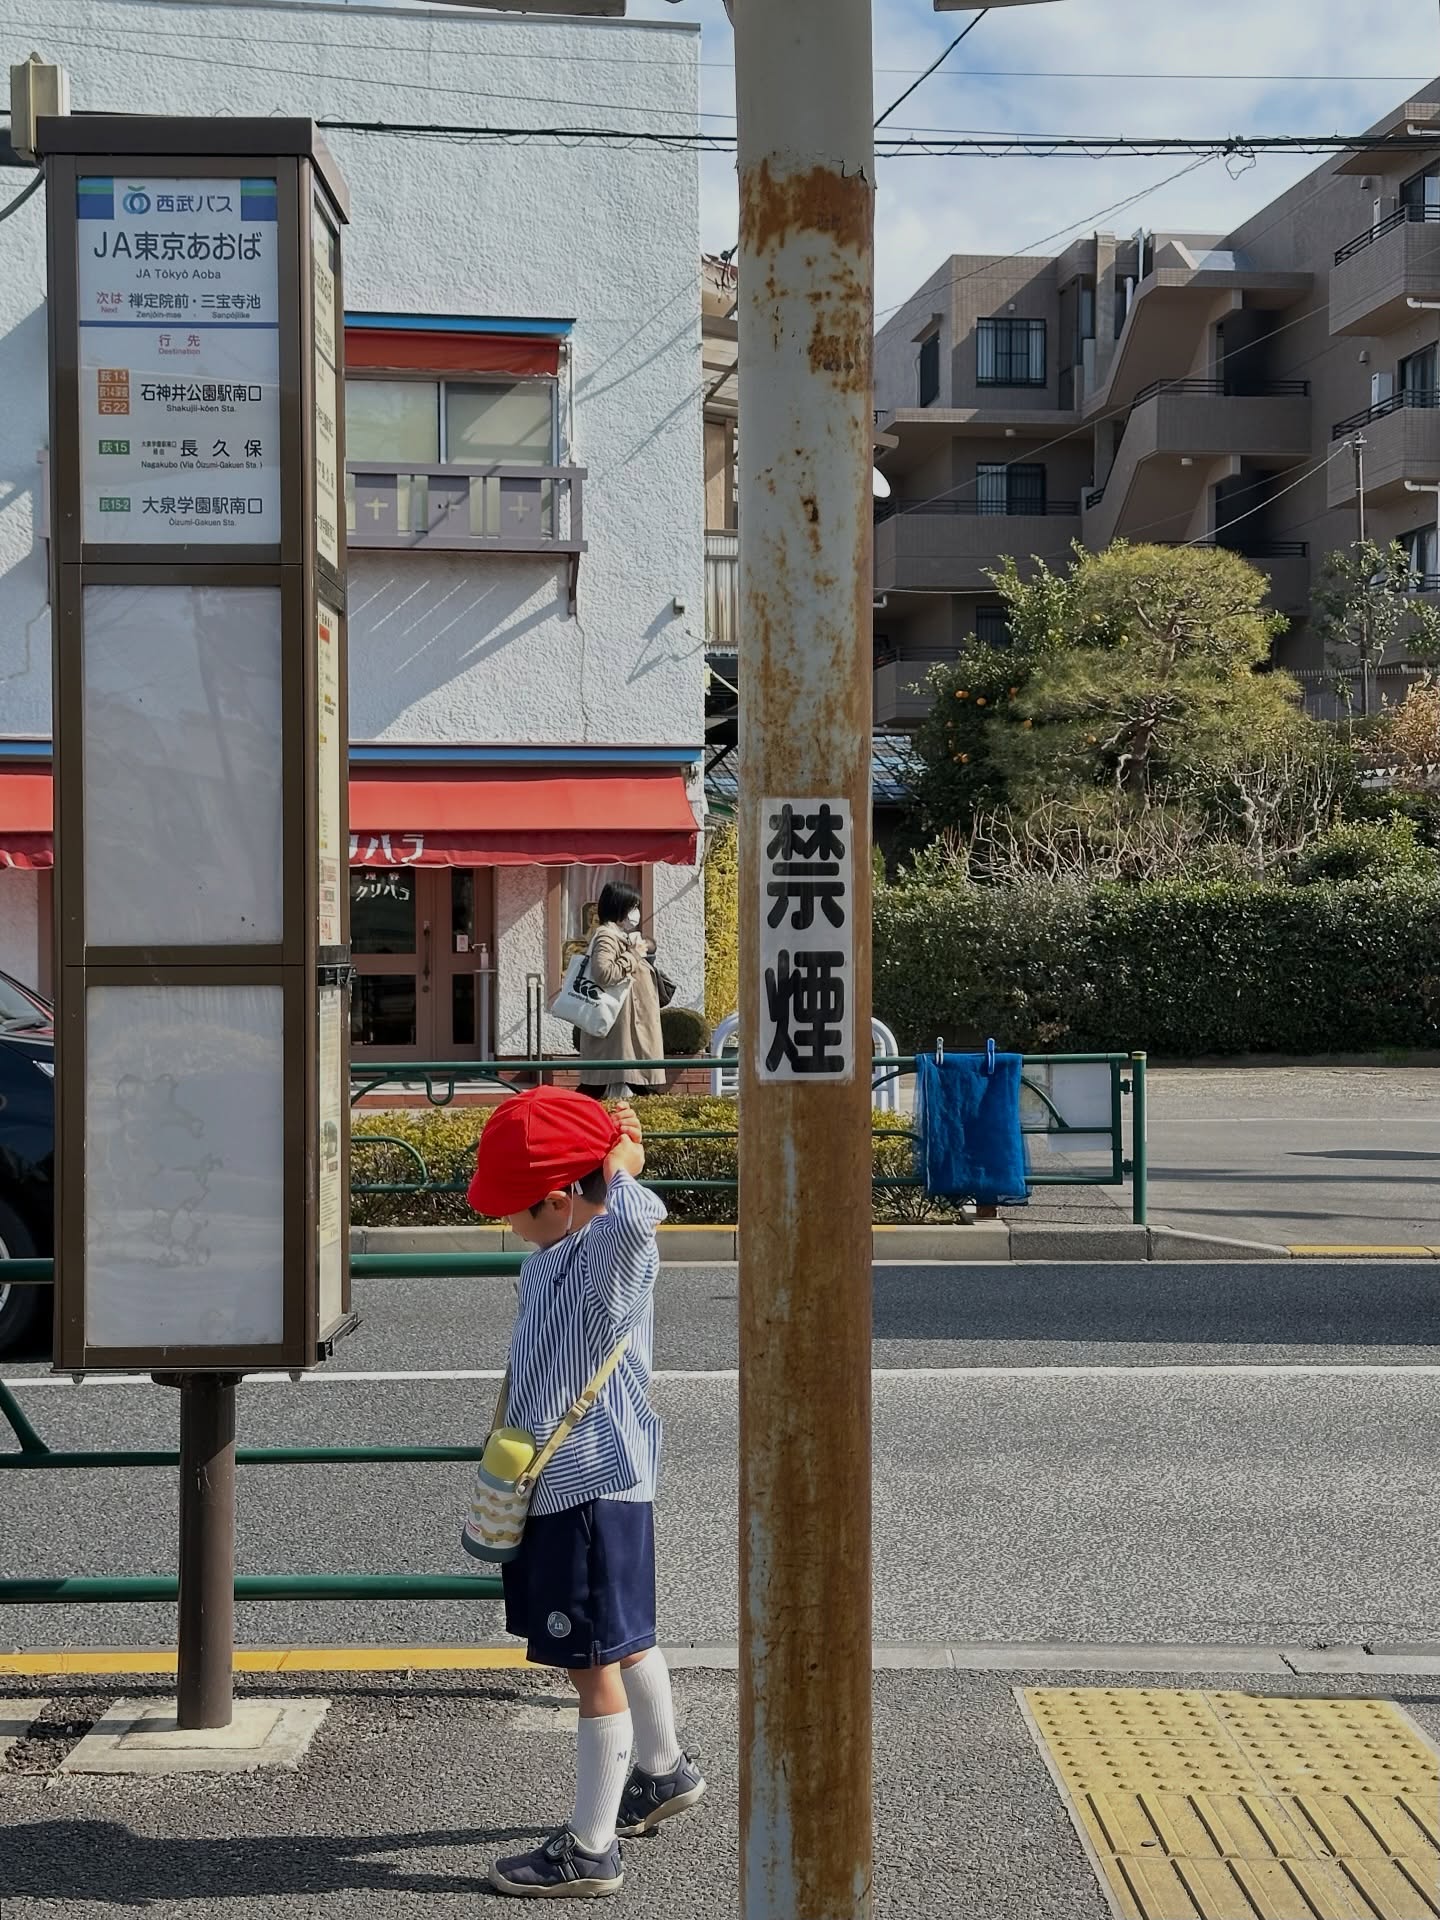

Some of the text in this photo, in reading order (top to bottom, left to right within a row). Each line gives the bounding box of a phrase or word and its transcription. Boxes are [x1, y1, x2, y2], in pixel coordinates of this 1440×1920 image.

[156, 194, 233, 213] 西武バス
[94, 231, 262, 261] JA東京あおば
[136, 268, 151, 279] JA
[192, 269, 221, 279] Aoba
[96, 292, 123, 305] 次は
[100, 306, 118, 314] Next
[158, 347, 201, 355] Destination
[100, 371, 127, 382] 荻14
[141, 384, 262, 401] 石神井公園駅南口
[101, 402, 128, 413] 石22
[101, 442, 128, 453] 荻15
[141, 461, 178, 469] Nagakubo
[142, 496, 262, 514] 大泉学園駅南口
[356, 883, 410, 902] クリハラ
[765, 803, 845, 1073] 禁煙
